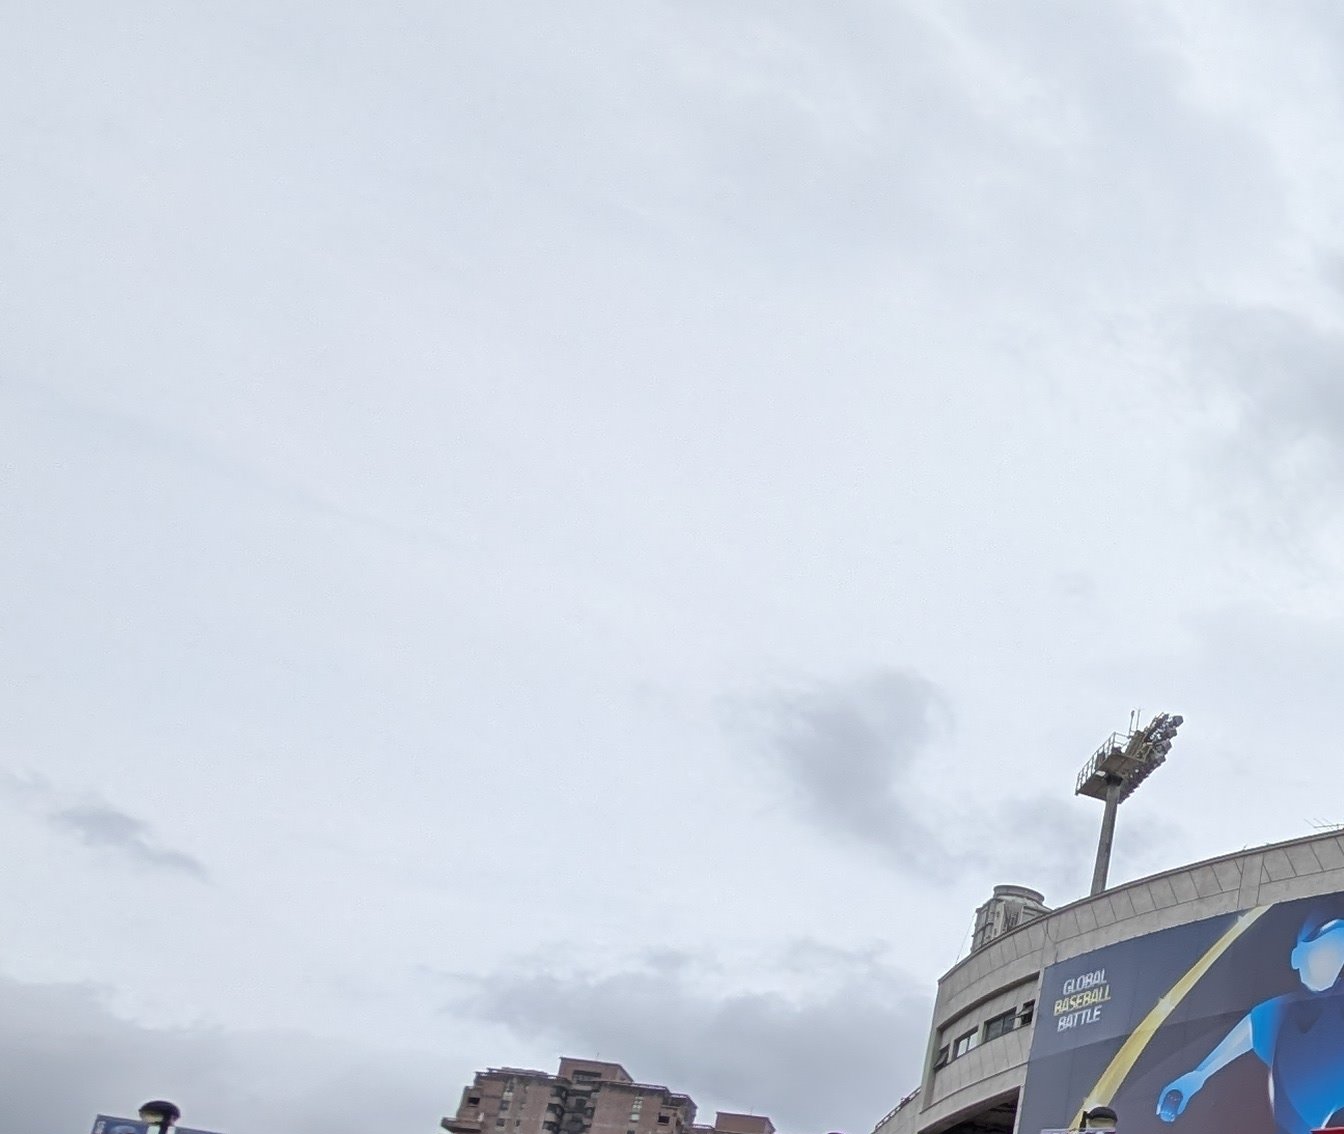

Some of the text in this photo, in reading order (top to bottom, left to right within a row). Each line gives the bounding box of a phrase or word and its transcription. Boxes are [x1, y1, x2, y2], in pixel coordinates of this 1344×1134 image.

[1063, 968, 1107, 995] GLOBAL
[1053, 984, 1111, 1016] BASEBALL
[1057, 1005, 1102, 1031] BATTLE
